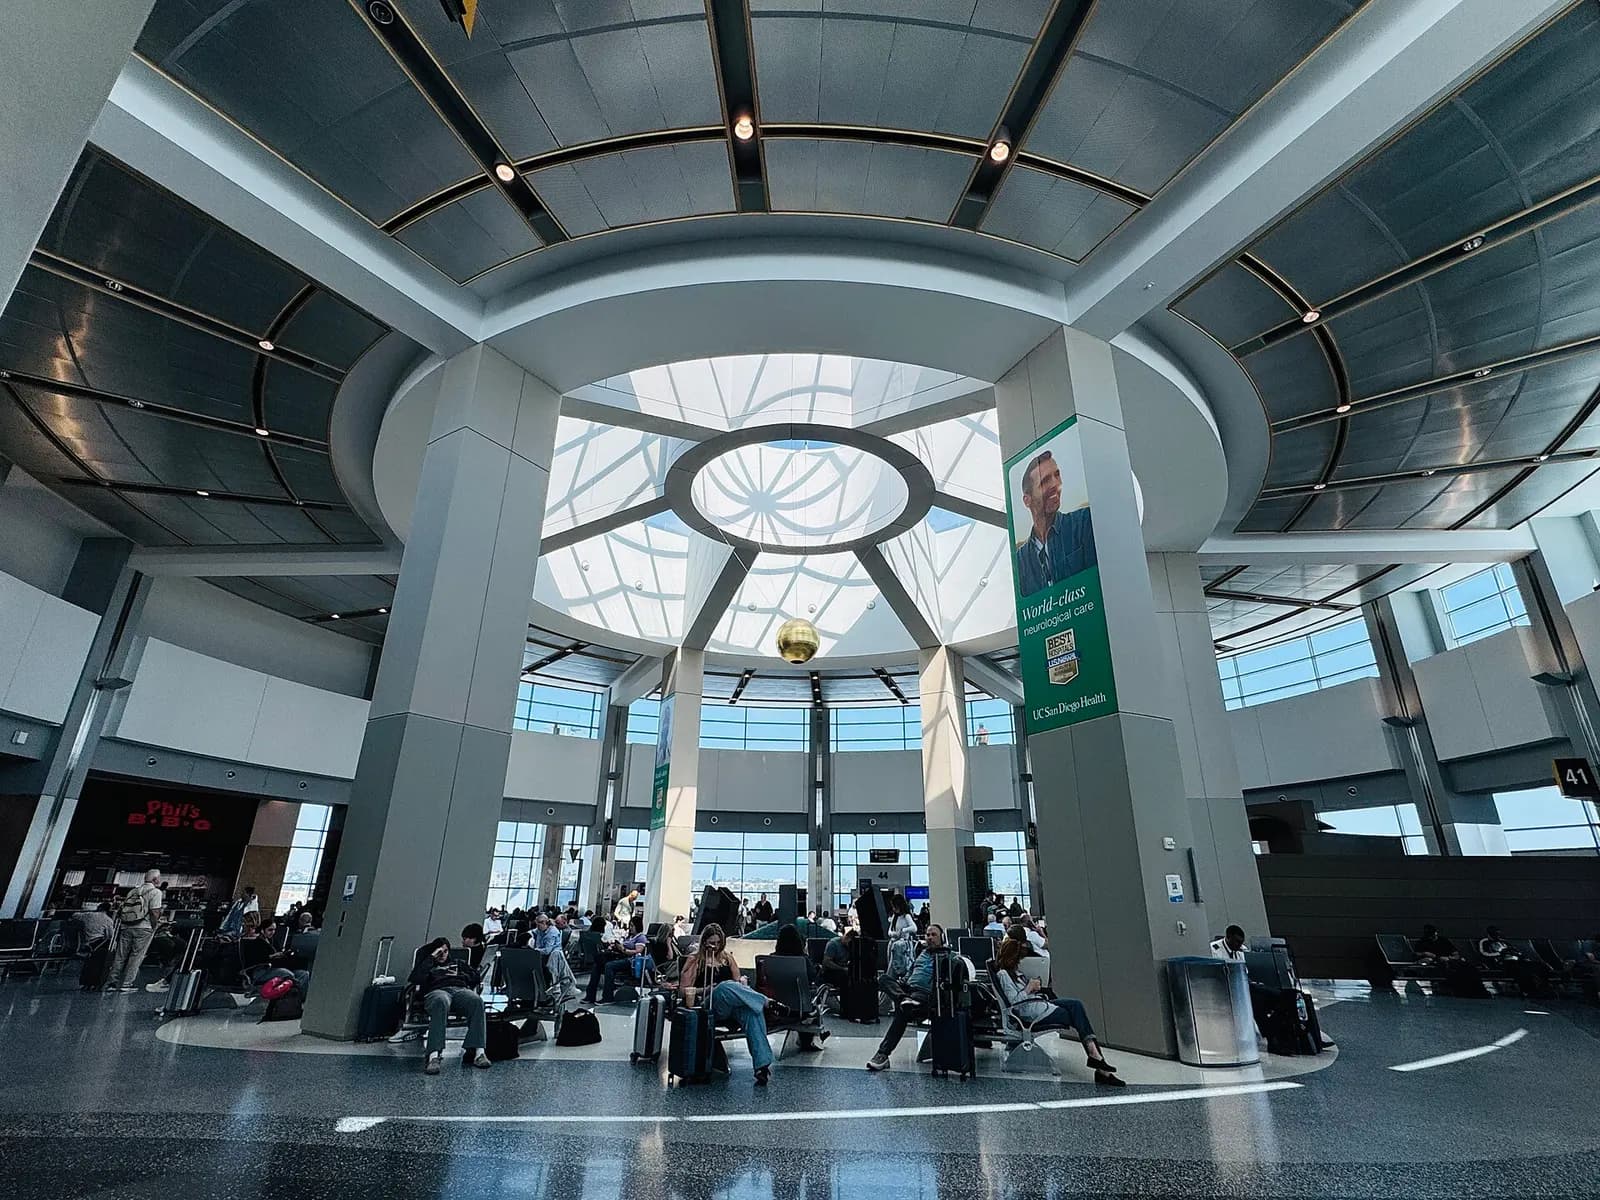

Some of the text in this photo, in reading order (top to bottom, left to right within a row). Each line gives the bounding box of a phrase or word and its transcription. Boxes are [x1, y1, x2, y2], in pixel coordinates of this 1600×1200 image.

[1022, 586, 1086, 622] World-class
[1023, 601, 1095, 637] neurological care
[1048, 631, 1073, 649] BEST
[1032, 692, 1107, 721] UC San Diego Health
[1566, 768, 1589, 785] 41
[146, 800, 201, 819] Phil's
[878, 871, 889, 880] 44
